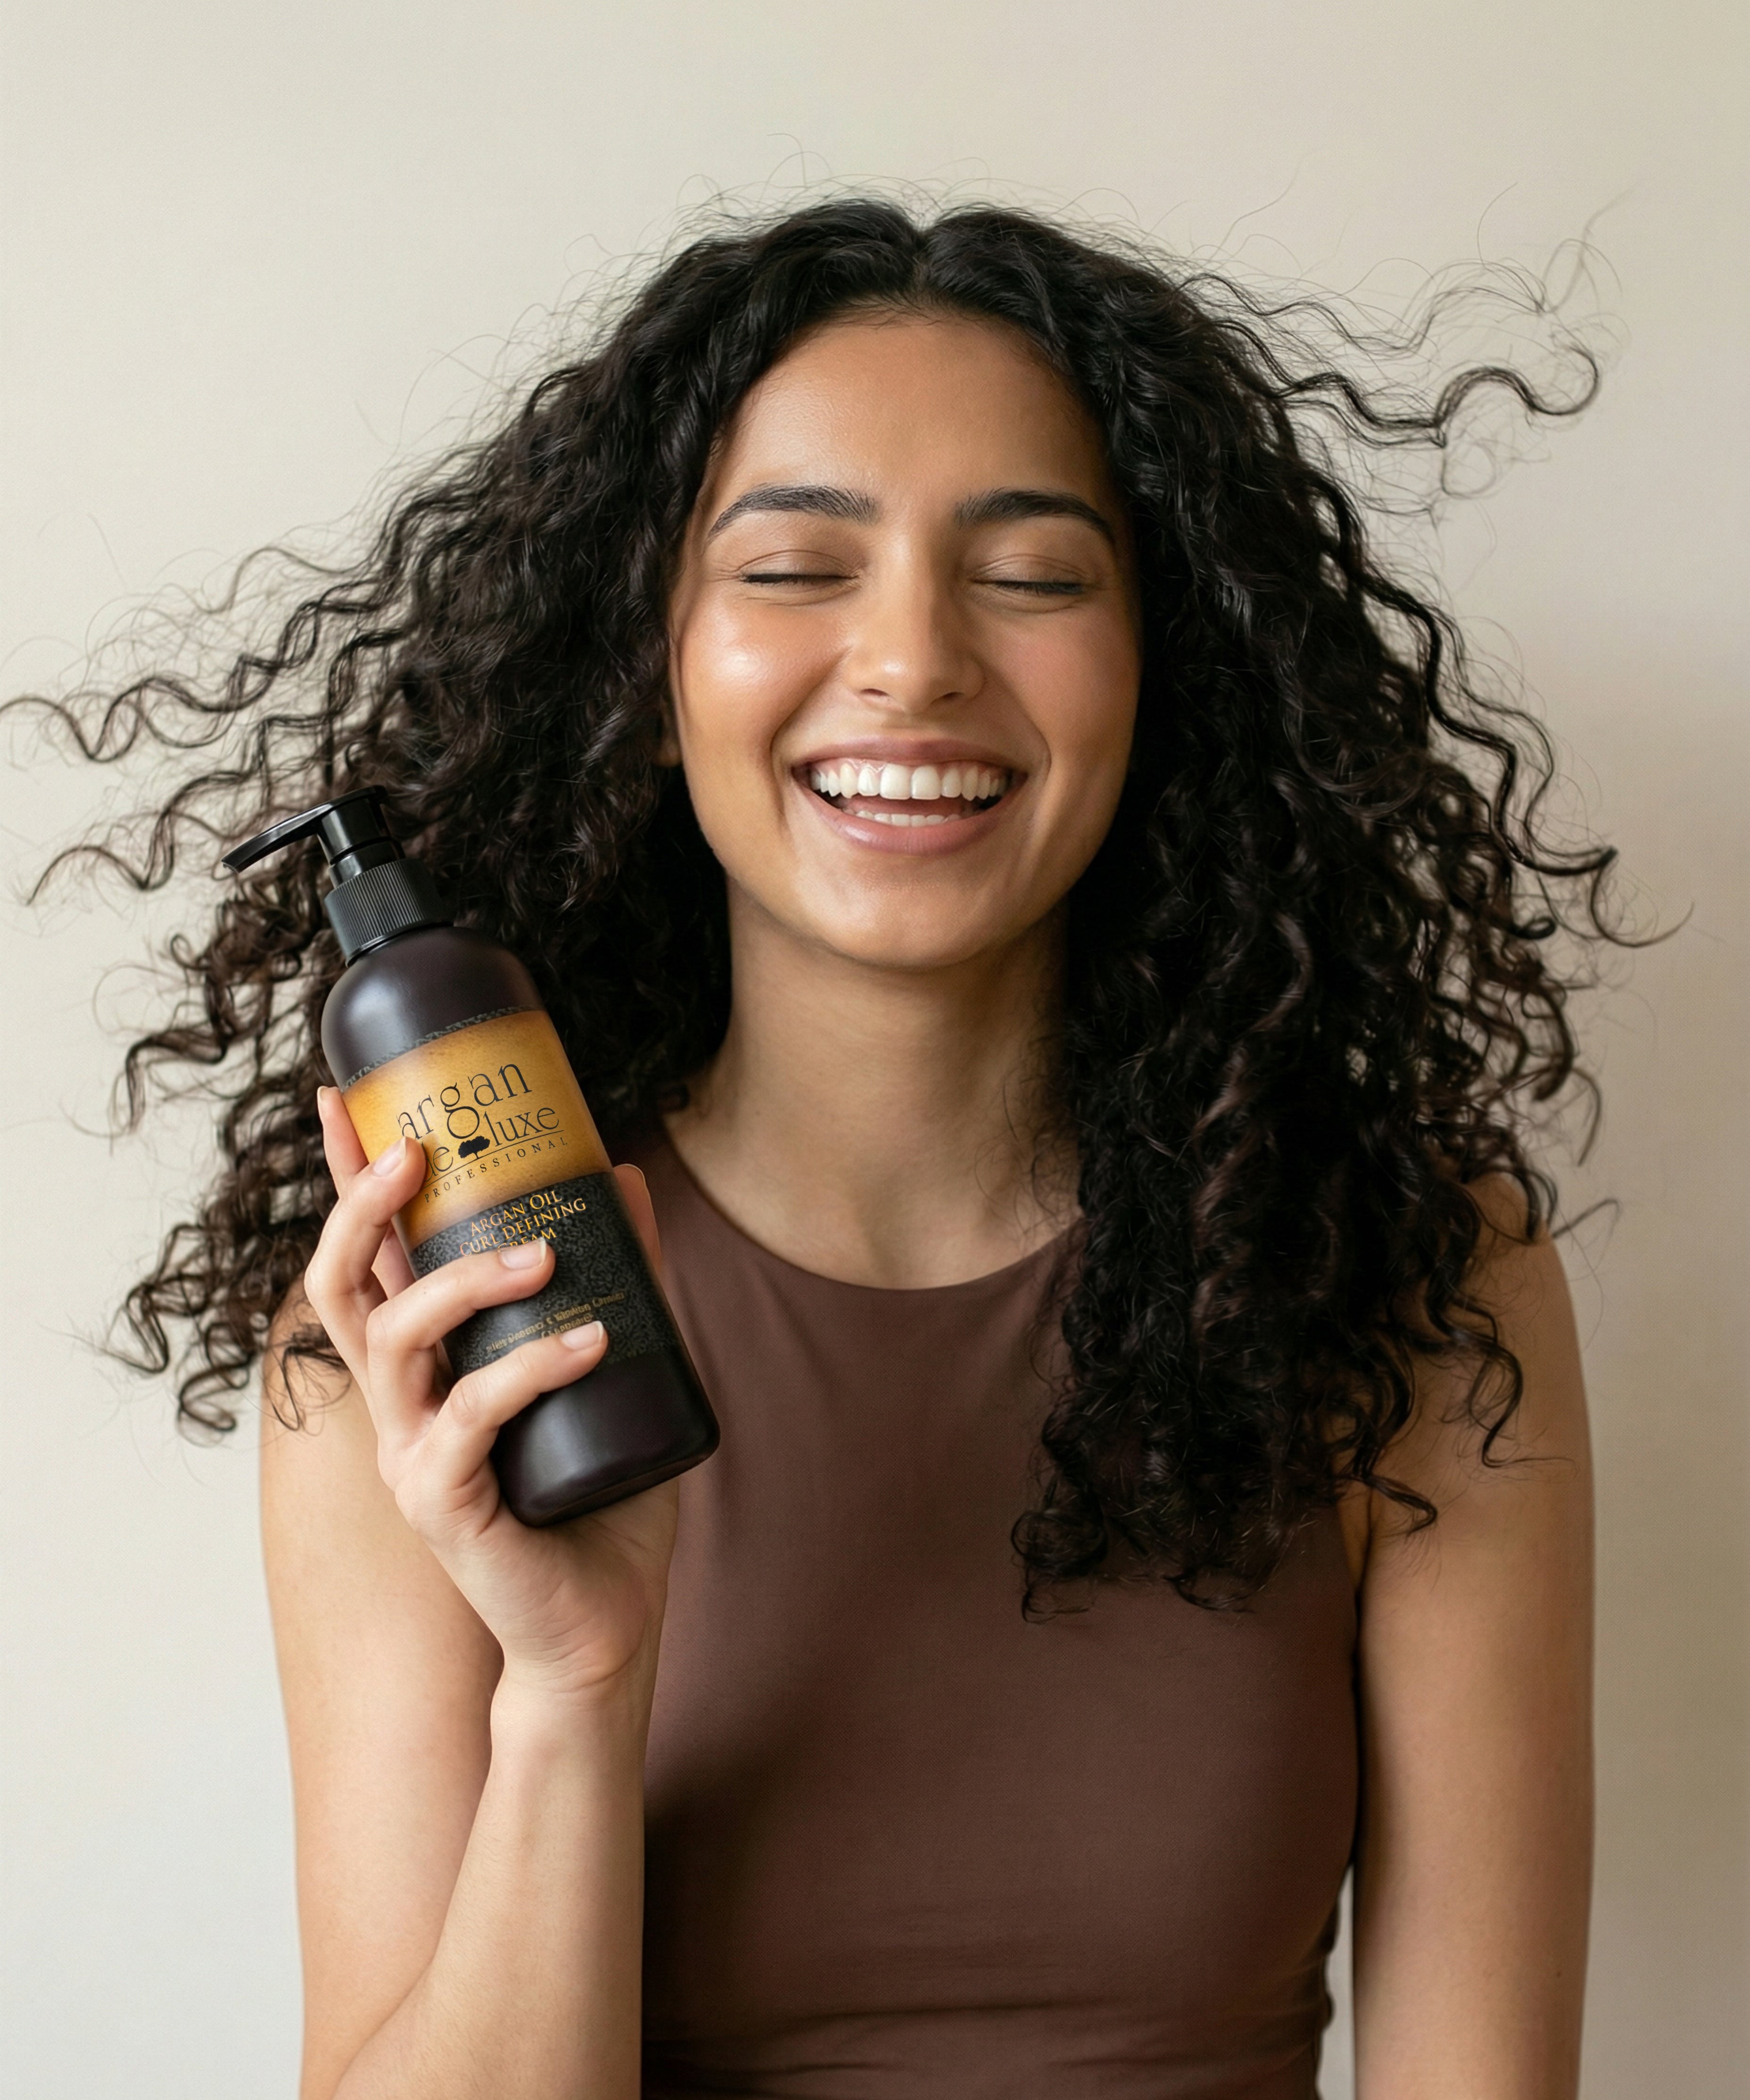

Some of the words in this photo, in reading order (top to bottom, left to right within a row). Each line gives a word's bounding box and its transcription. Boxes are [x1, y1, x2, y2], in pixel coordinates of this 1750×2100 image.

[396, 1064, 532, 1140] argan
[483, 1107, 560, 1147] luxe
[424, 1137, 568, 1203] PROFESSIONAL
[460, 1233, 500, 1257] CURL
[501, 1198, 586, 1240] DEFINING
[471, 1203, 526, 1237] ARGAN
[529, 1190, 562, 1210] OIL
